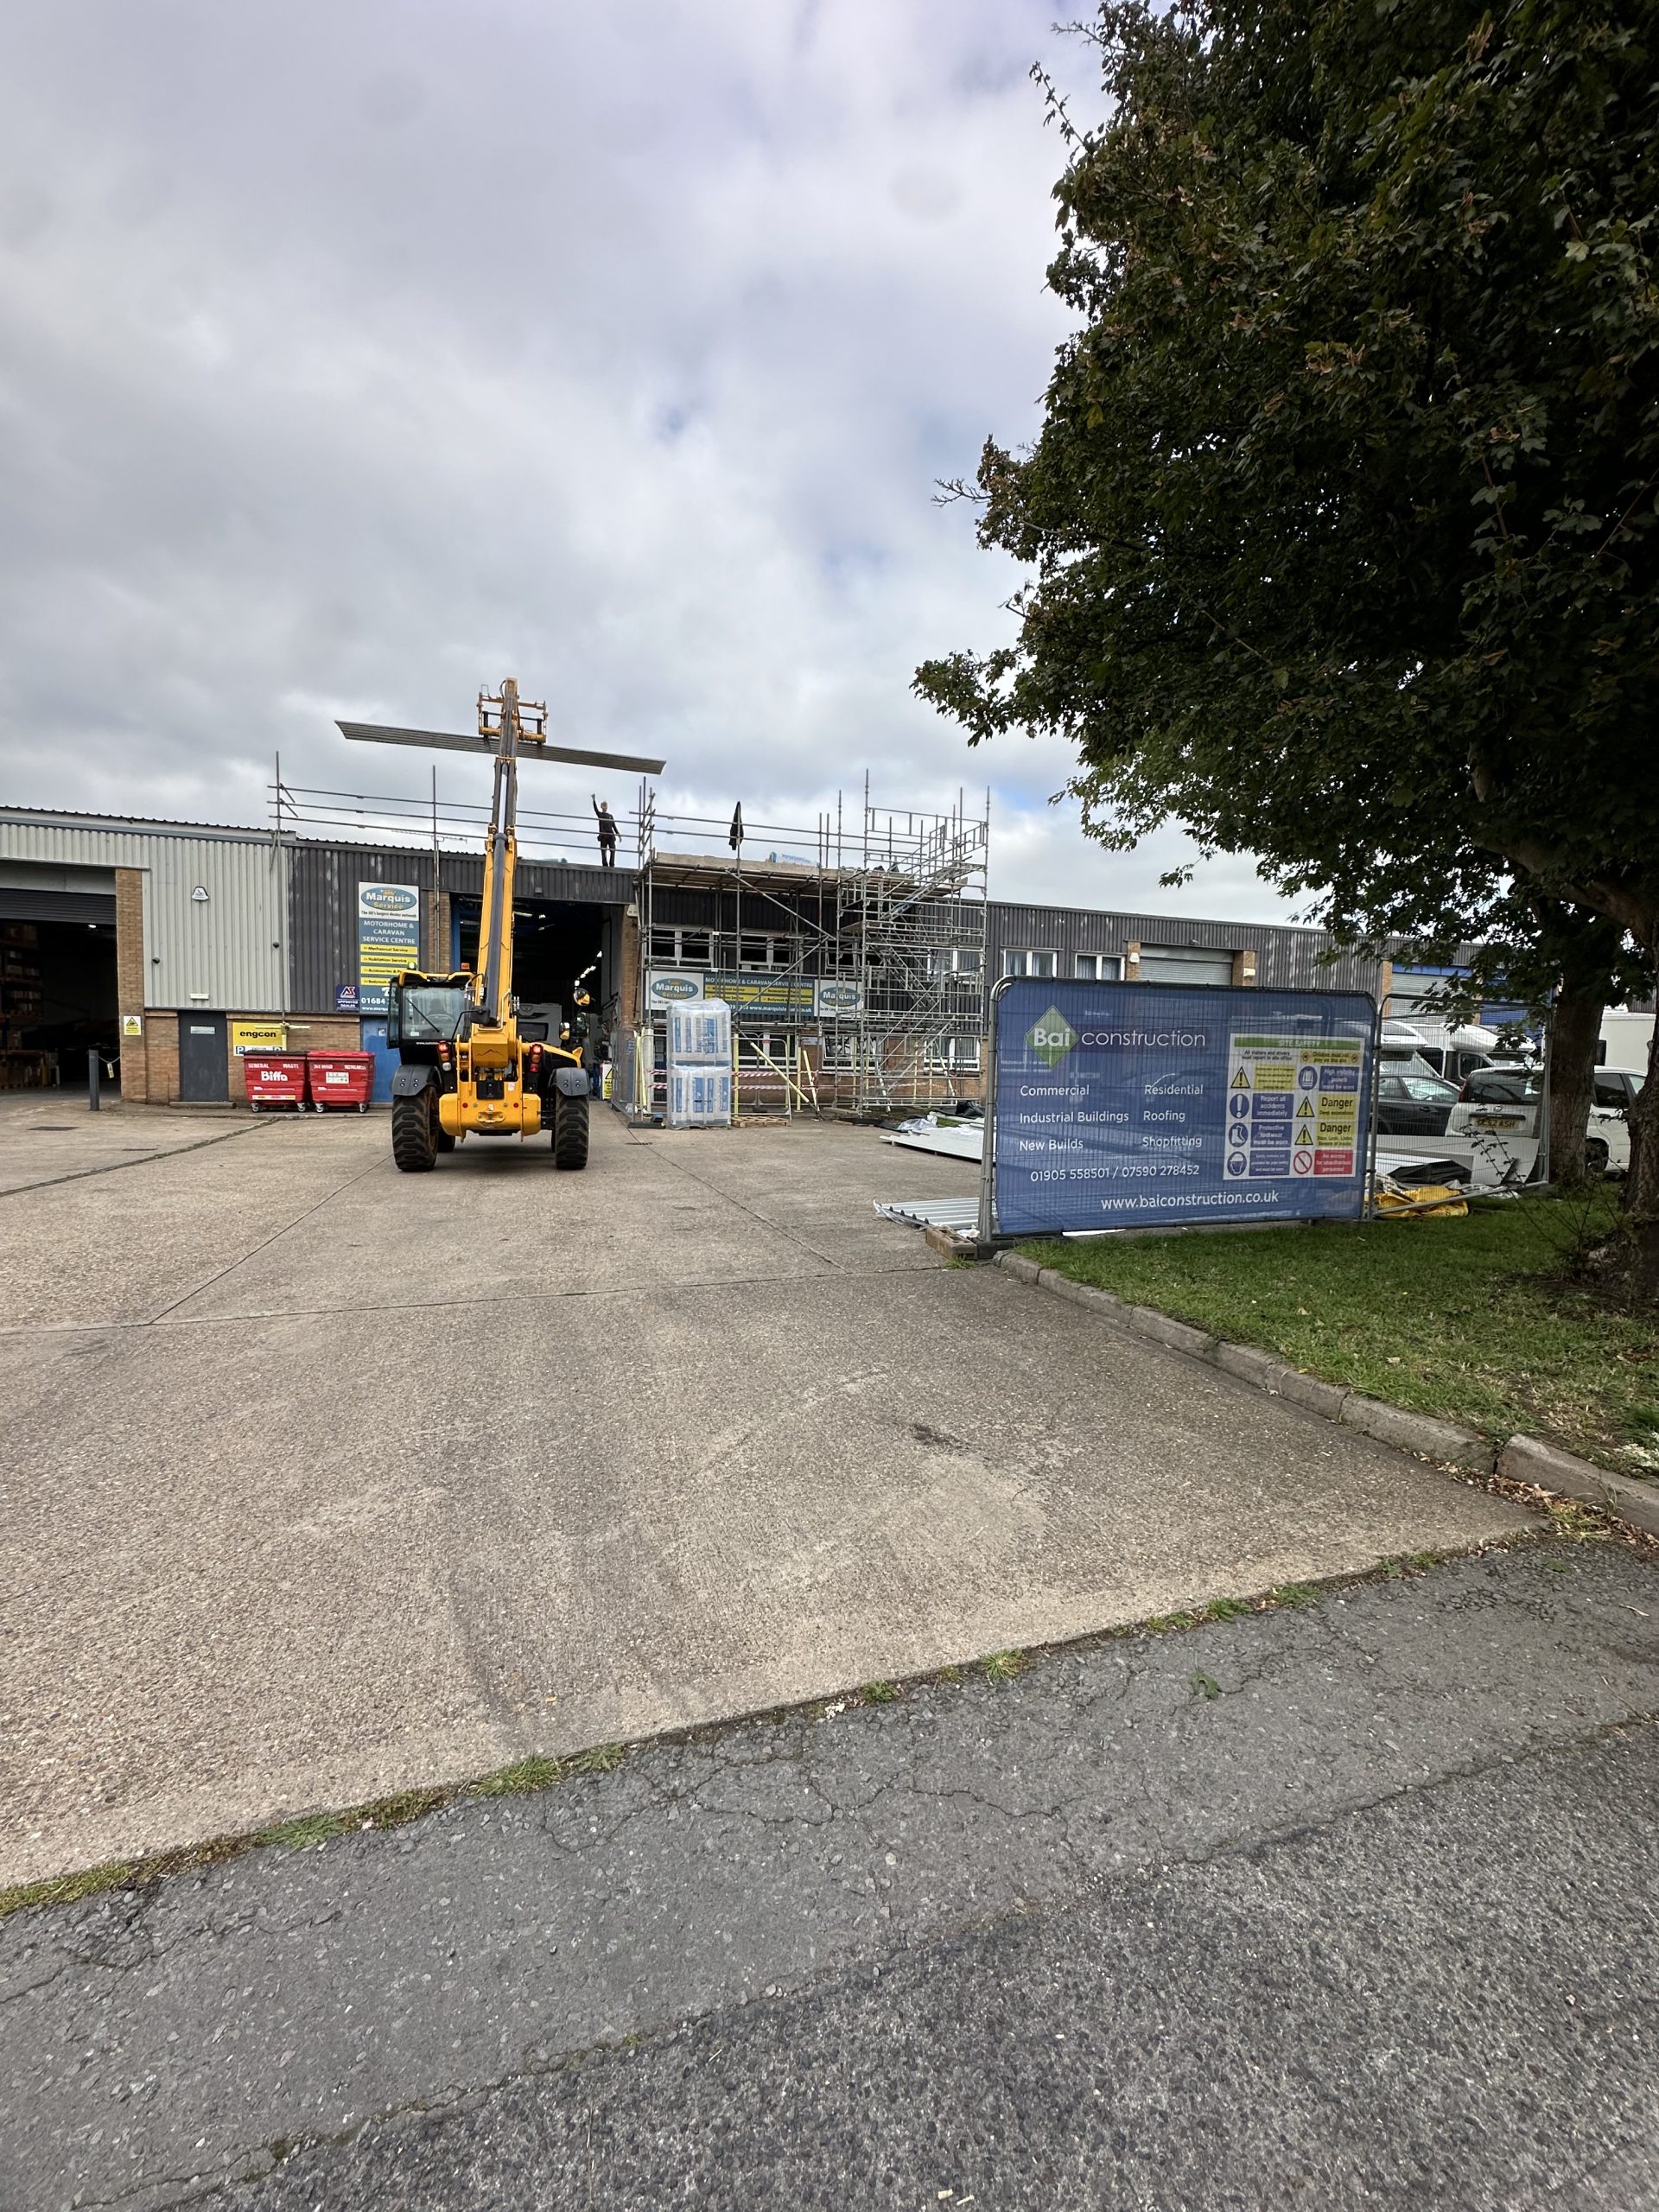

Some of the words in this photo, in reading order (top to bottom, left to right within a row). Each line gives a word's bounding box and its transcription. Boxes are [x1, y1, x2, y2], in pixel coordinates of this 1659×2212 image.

[365, 892, 411, 903] Marquis
[705, 976, 741, 985] MORHOME
[656, 982, 694, 993] Marquis
[823, 991, 856, 1000] Maquis
[239, 1030, 276, 1039] engcon
[1033, 1027, 1071, 1047] Bai
[1081, 1030, 1205, 1046] construction
[260, 1071, 289, 1081] Biffa
[1020, 1084, 1090, 1096] Commercial
[1144, 1084, 1204, 1096] Residential
[1321, 1096, 1353, 1109] Danger
[1020, 1111, 1074, 1124] Industrial
[1077, 1110, 1129, 1123] Buildings
[1143, 1110, 1185, 1122] Roofing
[1319, 1122, 1351, 1135] Danger
[1020, 1140, 1045, 1152] New
[1048, 1138, 1084, 1150] Builds
[1142, 1135, 1203, 1147] Shopfitting
[1030, 1169, 1066, 1182] 01905
[1069, 1167, 1109, 1180] 558501
[1111, 1166, 1119, 1179] /
[1122, 1166, 1157, 1178] 07590
[1160, 1164, 1200, 1176] 278452
[1100, 1189, 1280, 1210] www.baiconstruction.co.uk
